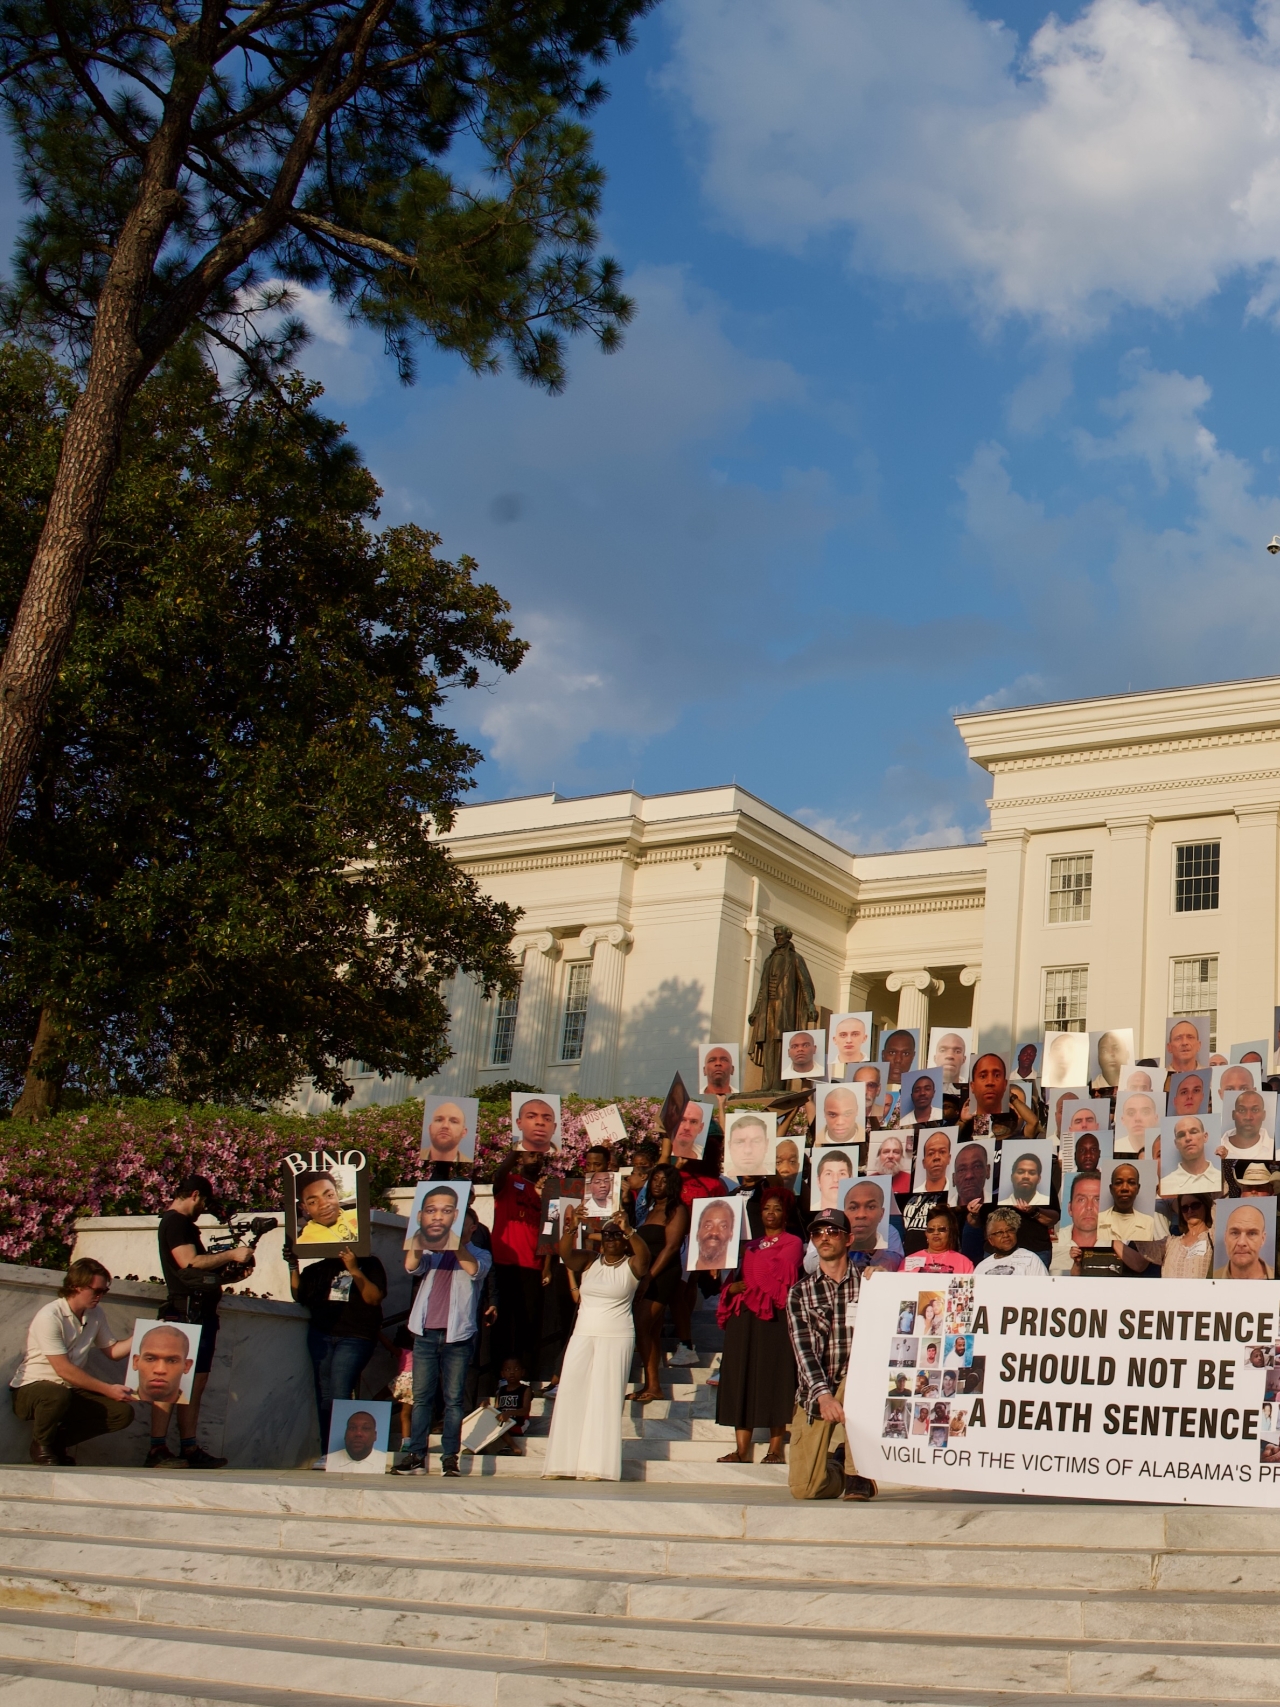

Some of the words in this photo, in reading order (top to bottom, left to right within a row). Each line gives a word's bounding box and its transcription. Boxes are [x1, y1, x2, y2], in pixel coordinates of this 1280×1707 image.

[600, 1120, 608, 1135] 4
[283, 1149, 367, 1177] BINO
[972, 1305, 989, 1335] A
[999, 1306, 1108, 1339] PRISON
[1118, 1309, 1274, 1343] SENTENCE
[999, 1352, 1116, 1386] SHOULD
[1127, 1357, 1188, 1389] NOT
[1196, 1359, 1236, 1391] BE
[967, 1397, 987, 1428] A
[997, 1399, 1093, 1433] DEATH
[1102, 1403, 1260, 1441] SENTENCE
[880, 1445, 927, 1464] VIGIL
[932, 1447, 972, 1467] FOR
[977, 1451, 1016, 1470] THE
[1021, 1453, 1100, 1475] VICTIMS
[1105, 1458, 1134, 1476] OF
[1138, 1460, 1252, 1483] ALABAMA'S
